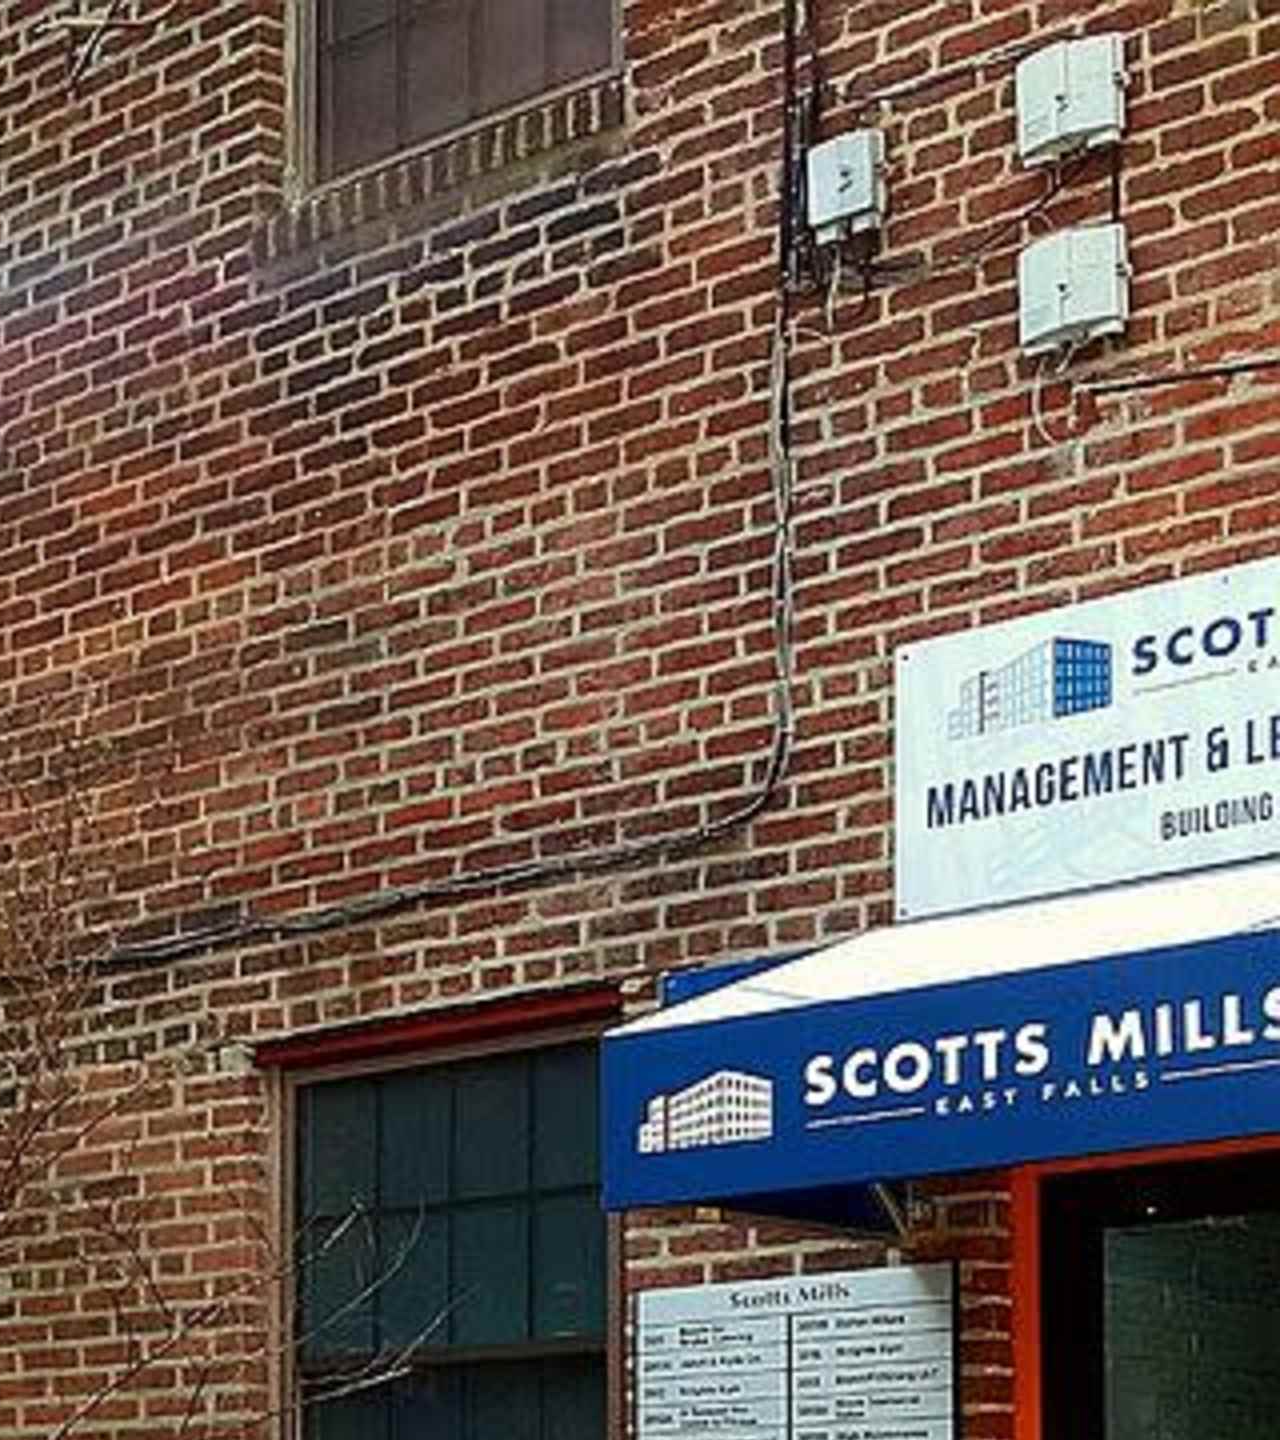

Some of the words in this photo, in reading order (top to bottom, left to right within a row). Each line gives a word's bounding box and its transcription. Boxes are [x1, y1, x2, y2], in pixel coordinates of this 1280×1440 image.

[1131, 607, 1276, 676] SCOT
[926, 733, 1190, 829] MANAGEMENT
[1206, 724, 1229, 773] &
[1160, 791, 1273, 841] BUILDING
[803, 1022, 1050, 1107] SCOTTS
[935, 1087, 1018, 1116] EAST
[1042, 1070, 1150, 1101] FALLS
